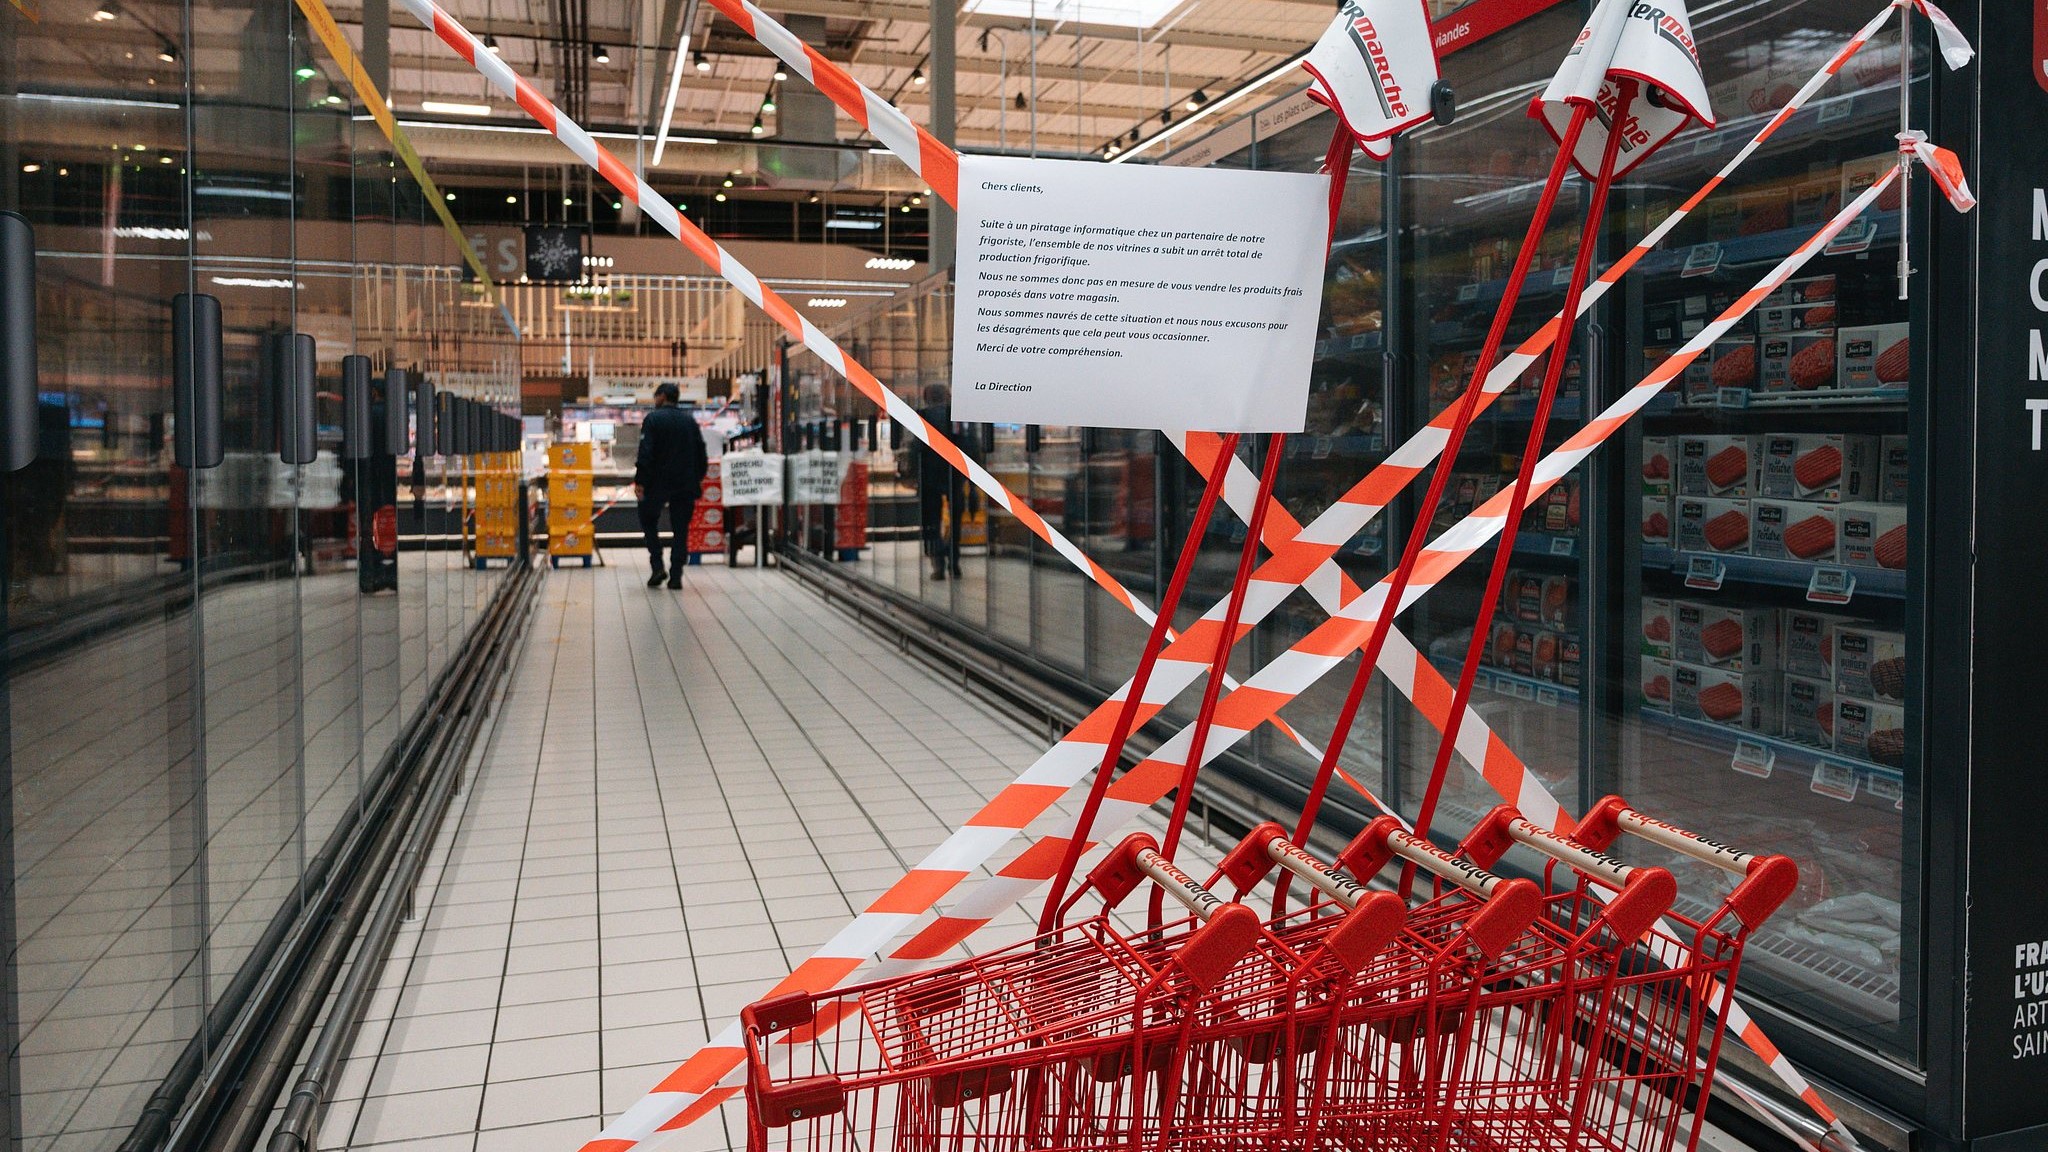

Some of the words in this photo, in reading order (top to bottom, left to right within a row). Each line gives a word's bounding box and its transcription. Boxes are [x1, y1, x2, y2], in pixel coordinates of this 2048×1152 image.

[1284, 104, 1300, 124] plats
[982, 182, 1008, 191] Chers
[1010, 183, 1044, 195] clients,
[980, 220, 1005, 230] Suite
[1007, 220, 1014, 230] à
[1016, 223, 1029, 231] un
[1030, 222, 1072, 235] piratage
[1073, 224, 1136, 238] informatique
[1137, 228, 1159, 238] chez
[1174, 232, 1225, 242] partenaire
[1226, 233, 1239, 243] de
[1240, 235, 1266, 244] notre
[979, 235, 1027, 248] frigoriste,
[1083, 241, 1095, 251] de
[1097, 244, 1114, 252] nos
[1116, 243, 1151, 254] vitrines
[1161, 246, 1186, 256] subit
[1201, 248, 1225, 258] arrêt
[1227, 250, 1250, 259] total
[1251, 250, 1263, 260] de
[979, 253, 1032, 263] production
[1033, 254, 1091, 268] frigorifique.
[978, 271, 1004, 282] Nous
[1020, 275, 1060, 284] sommes
[1062, 275, 1086, 286] donc
[1086, 279, 1104, 288] pas
[1120, 281, 1155, 289] mesure
[1157, 280, 1169, 290] de
[1171, 283, 1193, 291] vous
[1195, 283, 1227, 293] vendre
[1229, 284, 1242, 294] les
[1243, 286, 1282, 296] produits
[1282, 286, 1303, 298] frais
[977, 289, 1022, 299] proposés
[1024, 290, 1047, 300] dans
[1049, 292, 1075, 301] votre
[1076, 294, 1120, 304] magasin.
[977, 307, 1003, 317] Nous
[1004, 310, 1044, 319] sommes
[1046, 311, 1079, 321] navrés
[1080, 312, 1093, 321] de
[1094, 314, 1119, 323] cette
[1120, 314, 1163, 325] situation
[1164, 317, 1175, 325] et
[1176, 318, 1199, 326] nous
[1201, 320, 1223, 328] nous
[1225, 321, 1267, 330] excusons
[1267, 323, 1289, 332] pour
[977, 323, 991, 333] les
[992, 324, 1061, 336] désagréments
[1062, 329, 1081, 338] que
[1083, 328, 1103, 338] cela
[1104, 331, 1127, 340] peut
[1128, 332, 1151, 340] vous
[1152, 332, 1210, 343] occasionner.
[976, 343, 1005, 353] Merci
[1006, 344, 1019, 354] de
[1021, 346, 1047, 355] votre
[1048, 347, 1123, 358] compréhension.
[975, 381, 987, 392] La
[988, 382, 1033, 393] Direction
[2025, 398, 2048, 451] T
[2013, 1000, 2048, 1030] ART
